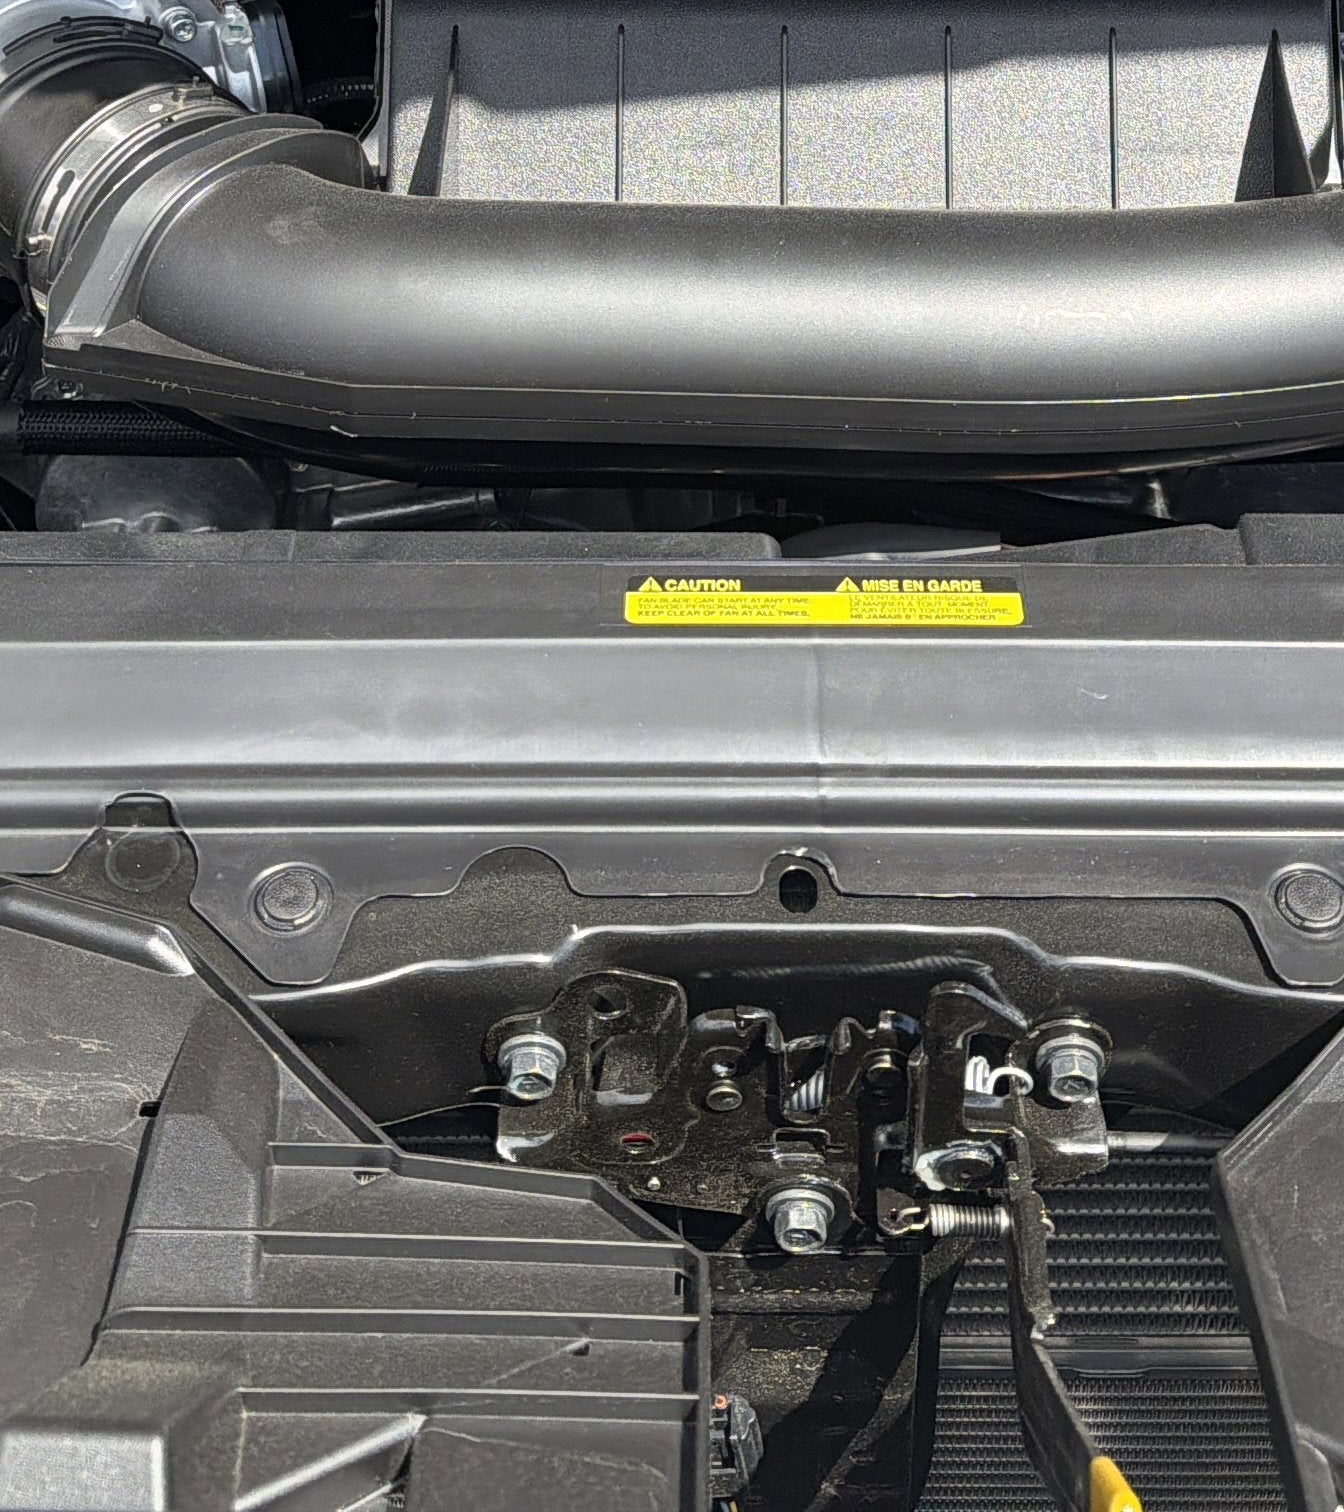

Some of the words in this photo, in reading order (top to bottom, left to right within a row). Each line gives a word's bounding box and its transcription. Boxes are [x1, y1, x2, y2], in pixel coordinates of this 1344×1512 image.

[664, 579, 741, 592] CAUTION
[861, 579, 900, 592] MISE
[902, 579, 923, 592] EN
[927, 579, 983, 592] GARDE
[637, 610, 664, 618] KEEP
[666, 610, 700, 618] CLEAR
[702, 610, 717, 618] OF
